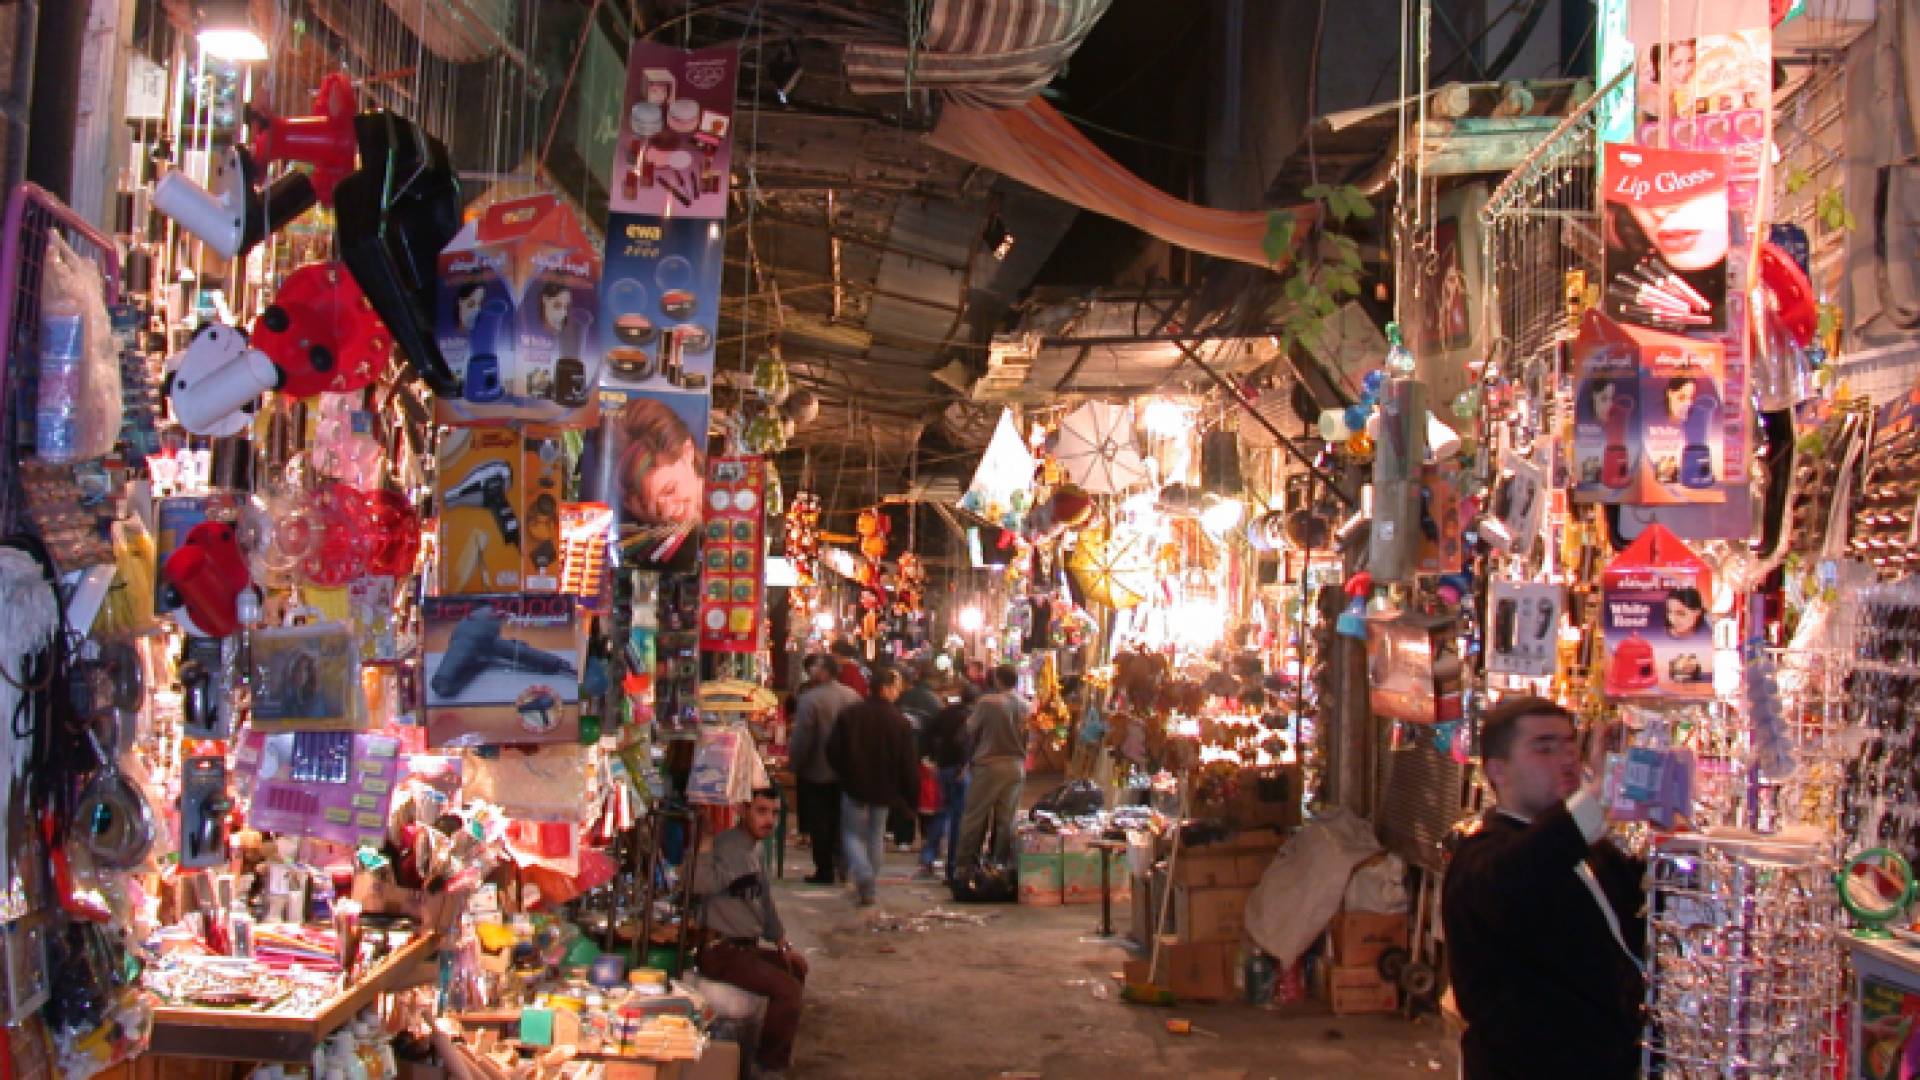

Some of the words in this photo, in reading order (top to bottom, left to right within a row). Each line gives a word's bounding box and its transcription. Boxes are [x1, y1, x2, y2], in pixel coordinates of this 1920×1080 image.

[1615, 174, 1651, 200] Lip
[1654, 168, 1716, 193] Gloss
[626, 224, 662, 240] ewa
[1609, 601, 1651, 614] White
